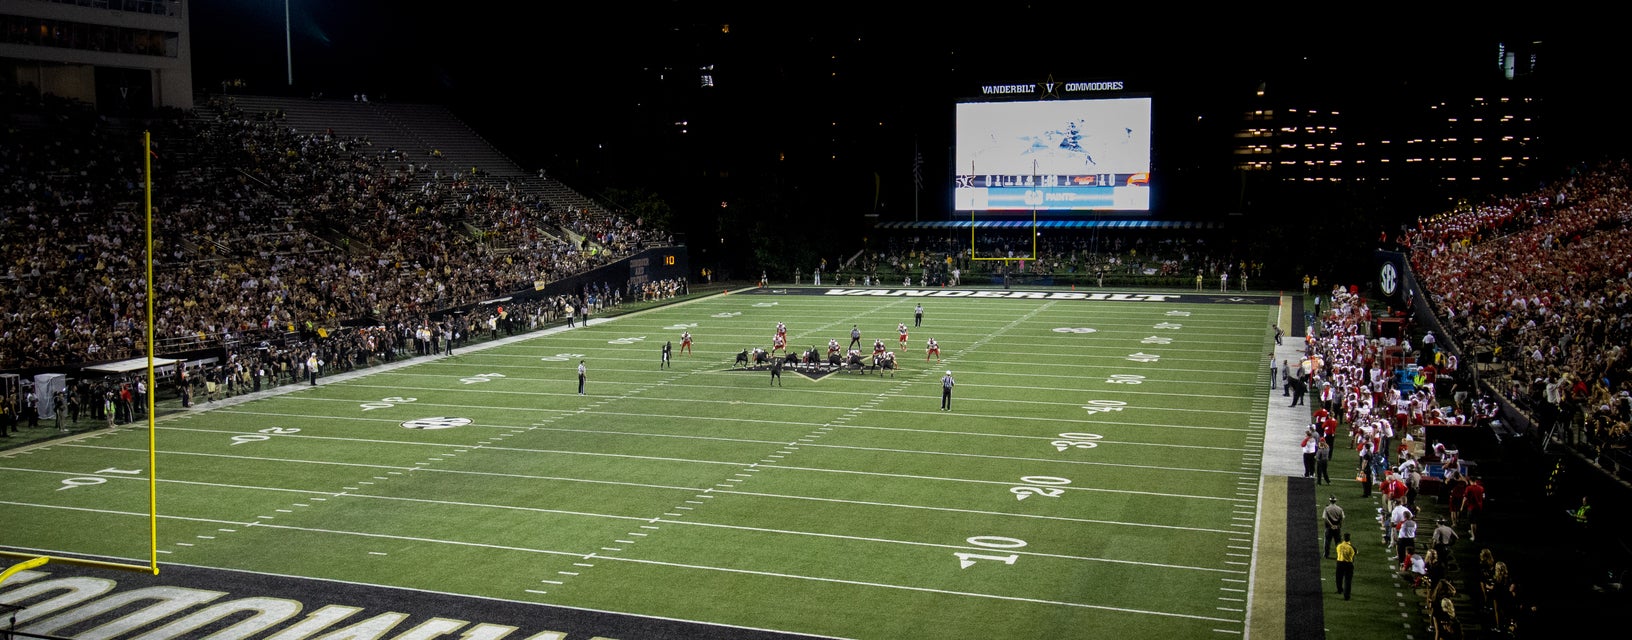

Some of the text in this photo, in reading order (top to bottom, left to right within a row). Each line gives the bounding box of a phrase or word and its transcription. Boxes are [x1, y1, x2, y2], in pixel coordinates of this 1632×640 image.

[982, 81, 1124, 94] VANDERBILT V COMMODORES
[666, 255, 675, 265] 10
[824, 288, 1181, 302] VANDERBILT
[1081, 399, 1128, 413] 40
[231, 426, 301, 444] 20
[1050, 432, 1104, 450] 30
[60, 466, 143, 488] 10
[1009, 475, 1072, 498] 20
[953, 535, 1029, 567] 10
